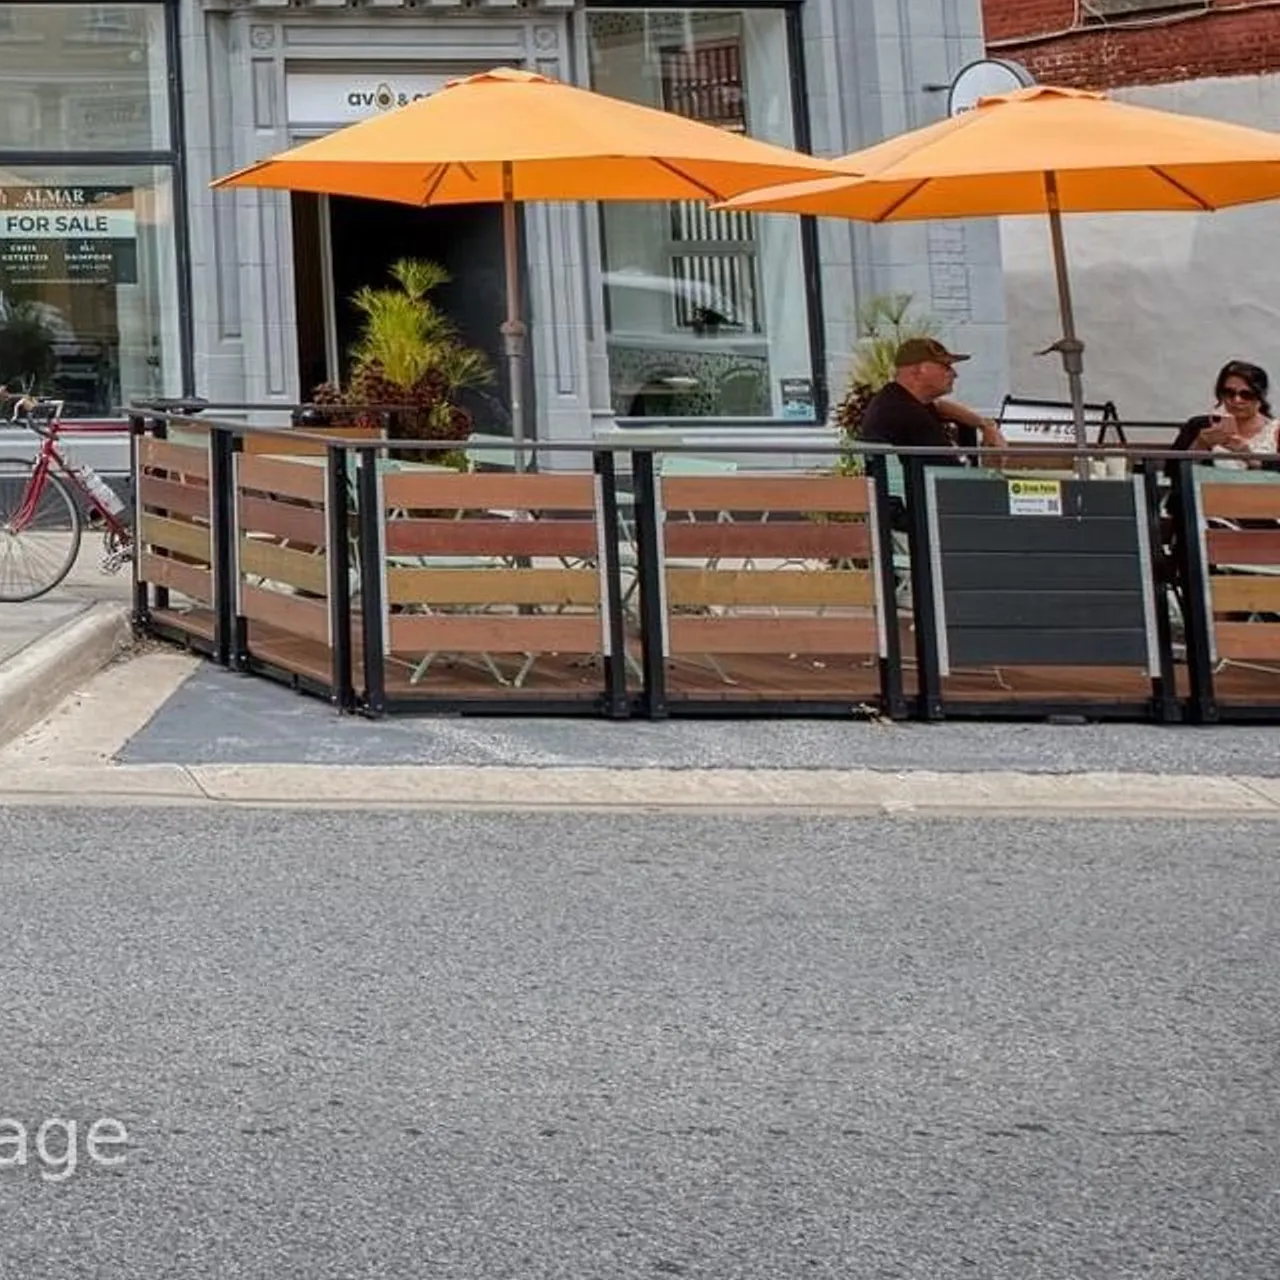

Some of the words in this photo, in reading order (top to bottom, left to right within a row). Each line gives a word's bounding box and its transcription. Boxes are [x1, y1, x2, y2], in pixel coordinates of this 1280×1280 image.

[24, 188, 85, 203] ALMAR
[7, 216, 49, 231] FOR
[56, 216, 108, 231] SALE
